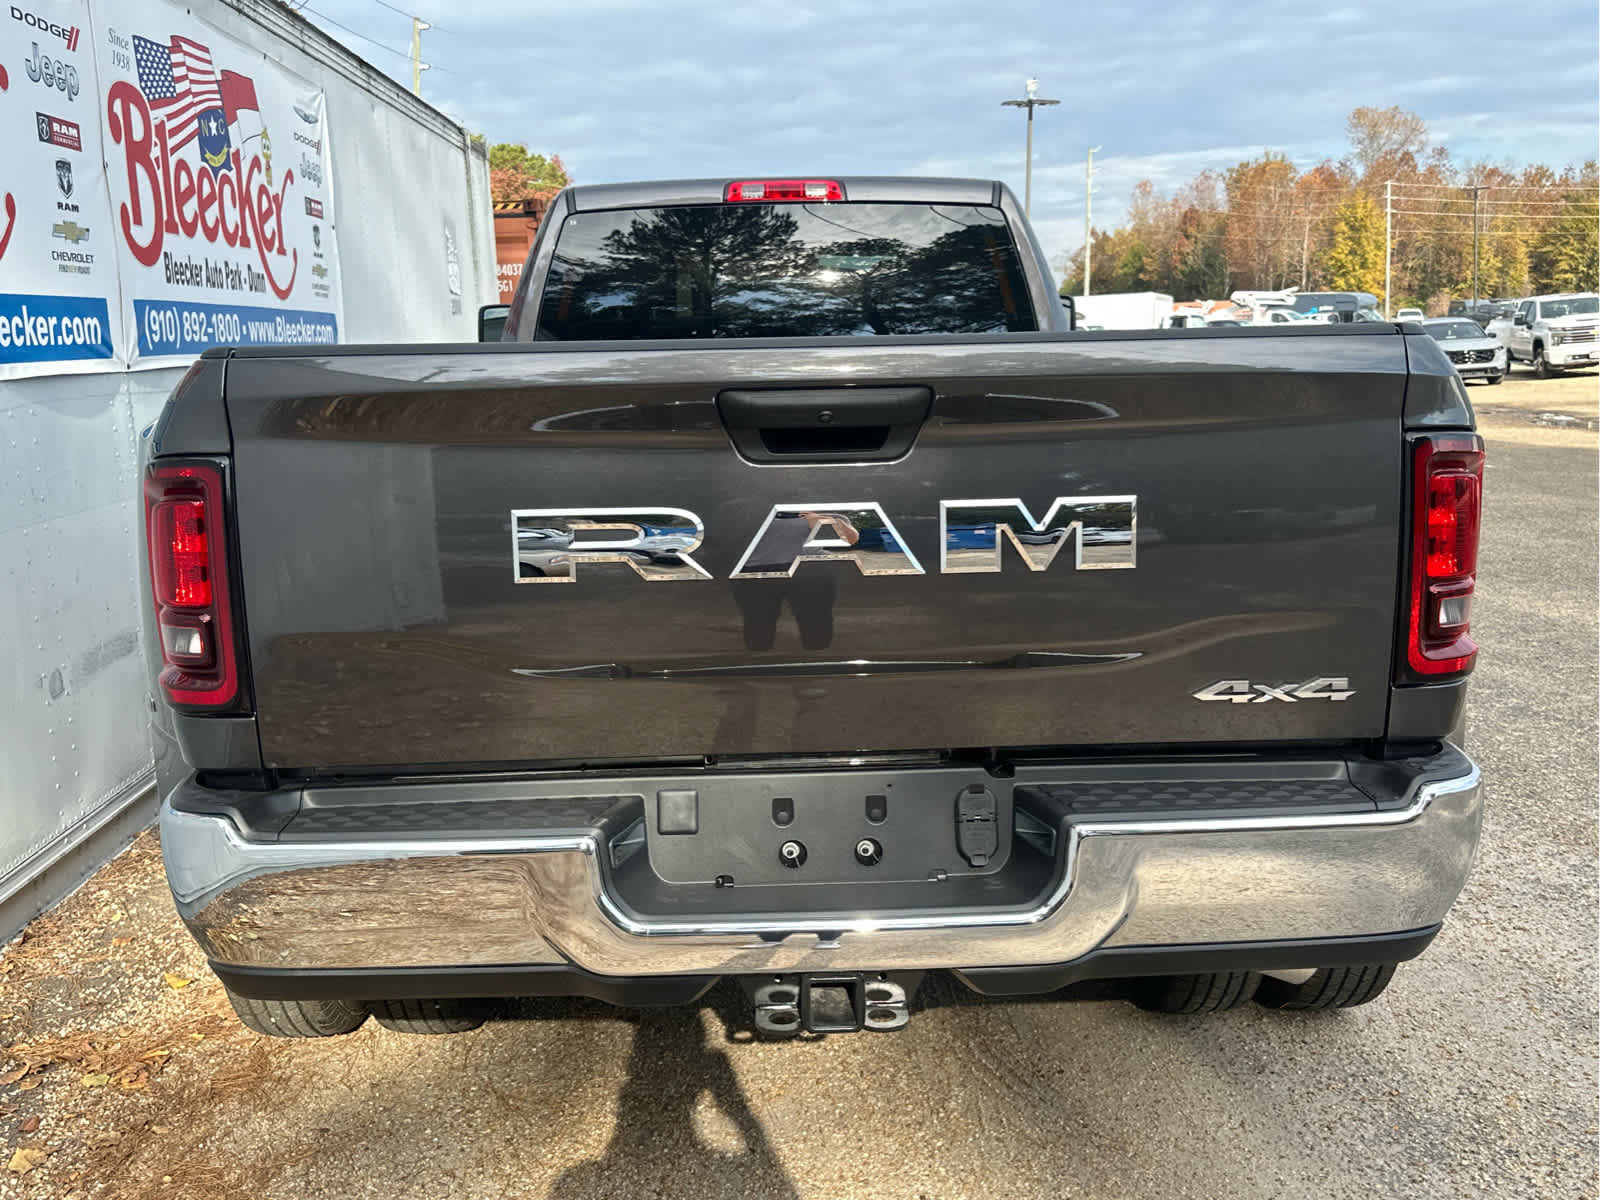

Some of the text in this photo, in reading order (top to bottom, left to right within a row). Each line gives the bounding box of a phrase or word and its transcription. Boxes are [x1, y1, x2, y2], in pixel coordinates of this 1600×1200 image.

[10, 6, 72, 41] DODGE
[108, 28, 129, 50] Since
[25, 41, 80, 102] Jeep
[112, 50, 130, 72] 1938
[52, 121, 79, 138] RAM
[57, 201, 80, 213] RAM
[108, 80, 297, 300] Bleecker
[51, 250, 94, 264] CHEVROLET
[163, 251, 203, 288] Bleecker
[205, 257, 225, 290] Auto
[224, 260, 243, 291] Park
[248, 263, 267, 294] Dunn
[0, 305, 102, 347] ecker.com
[145, 305, 335, 350] (910) 892-1800 www.Bleecker.com
[511, 495, 1138, 584] RAM
[1193, 677, 1357, 703] 4x4
